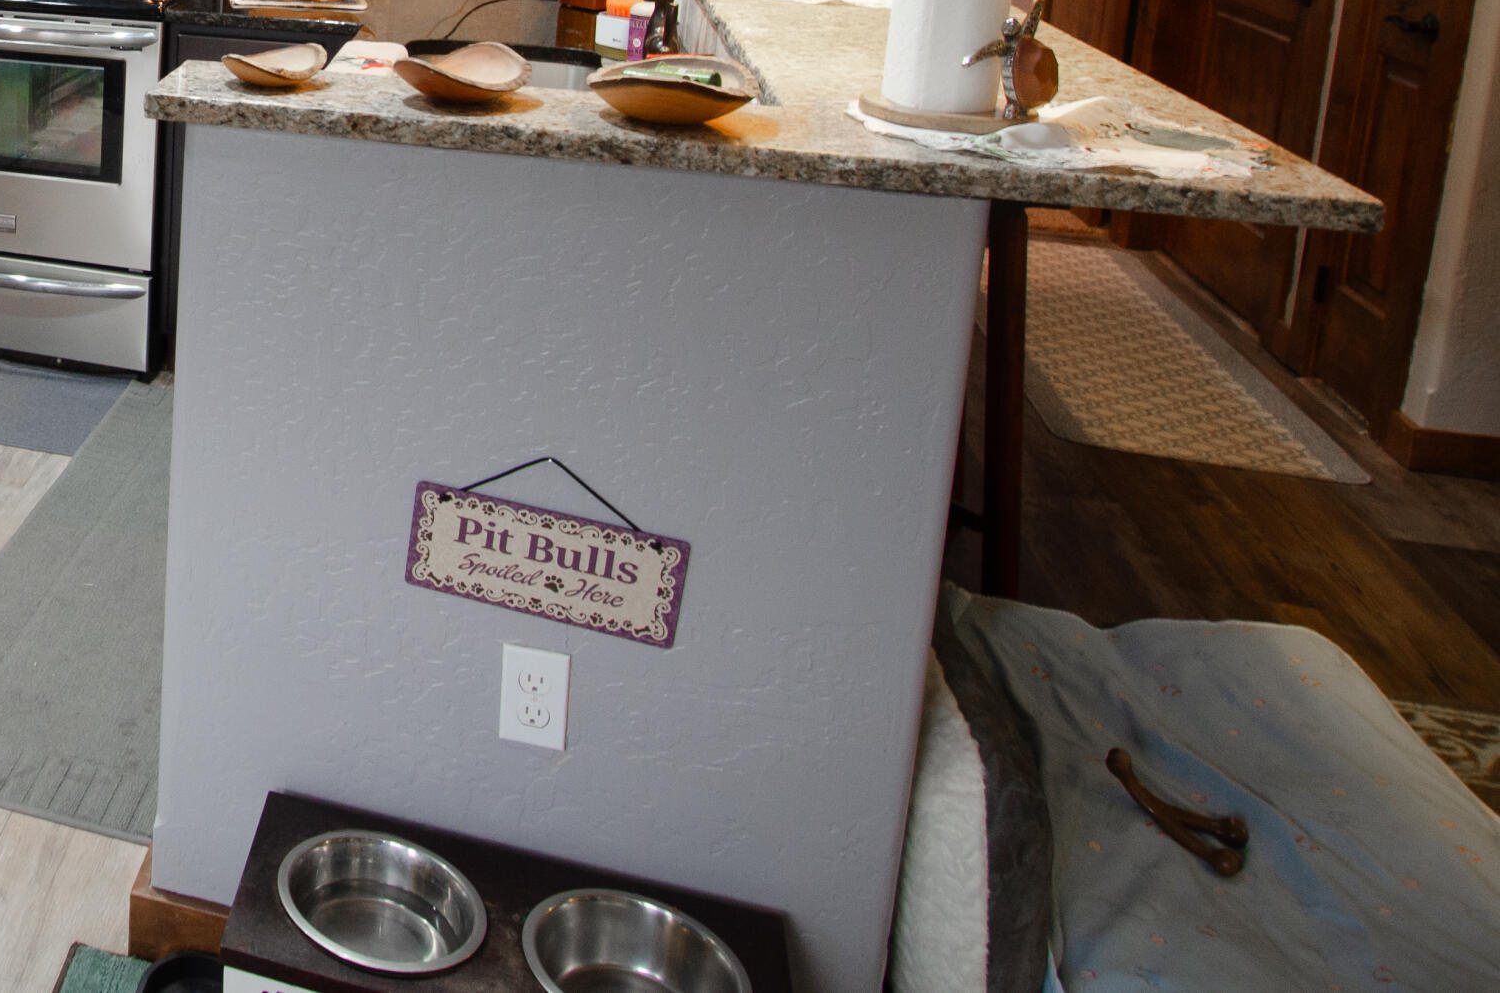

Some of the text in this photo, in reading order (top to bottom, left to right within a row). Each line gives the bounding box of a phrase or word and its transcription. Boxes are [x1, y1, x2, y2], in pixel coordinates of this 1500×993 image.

[454, 515, 639, 584] Pit Bulls
[458, 552, 625, 608] Spoiled Here
